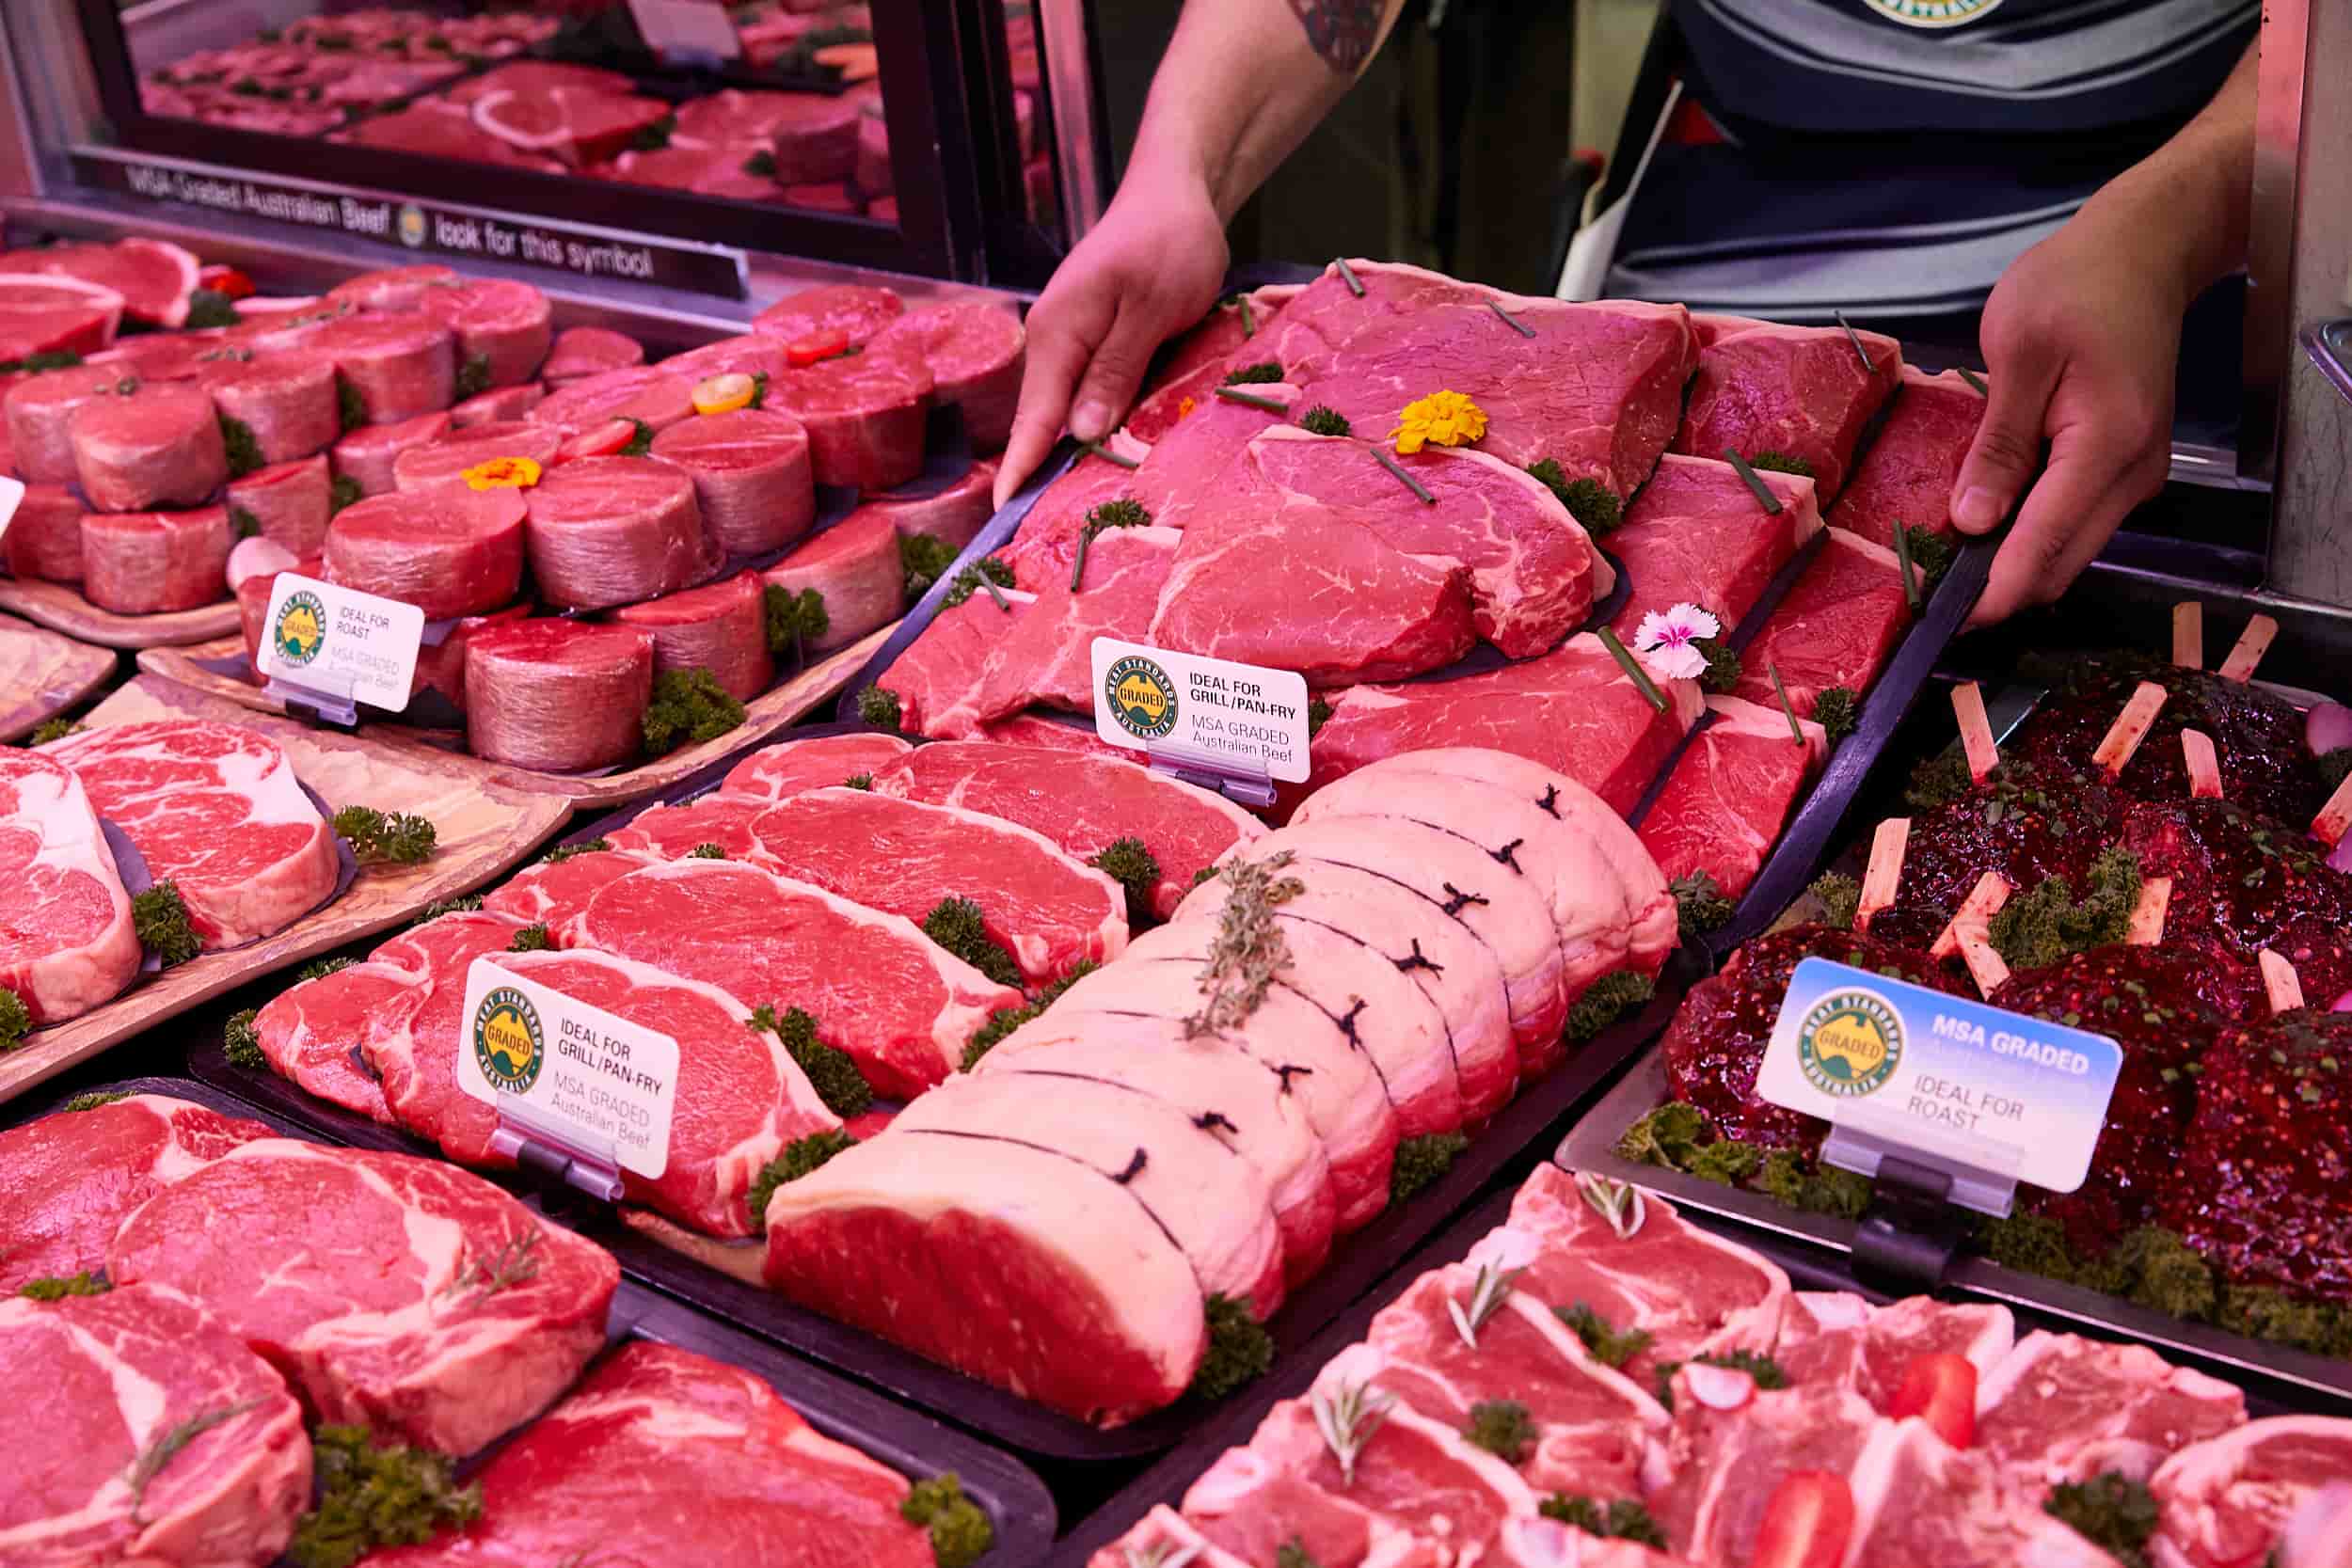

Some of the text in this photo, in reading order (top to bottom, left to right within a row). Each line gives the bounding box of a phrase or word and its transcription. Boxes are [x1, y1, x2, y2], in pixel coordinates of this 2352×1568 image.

[244, 182, 339, 225] Australian
[341, 196, 390, 233] Beef
[435, 213, 483, 250] look
[485, 221, 516, 256] for
[519, 229, 564, 264] this
[566, 242, 655, 278] symbol
[337, 621, 370, 640] ROAST
[340, 607, 389, 629] IDEAL FOR
[1108, 664, 1122, 694] MEAT
[1125, 658, 1175, 706] STANDARDS
[1189, 672, 1261, 697] IDEAL FOR
[1120, 688, 1164, 707] GRADED
[1116, 712, 1170, 737] AUSTRALIA
[1192, 714, 1289, 745] MSA GRADED
[1193, 731, 1292, 763] Australian Beef
[477, 998, 495, 1032] MEAT
[500, 990, 542, 1056] STANDARDS
[1804, 1003, 1833, 1037] MEAT
[1842, 997, 1899, 1060] STANDARDS
[487, 1025, 531, 1057] GRADED
[561, 1017, 630, 1061] IDEAL FOR
[1820, 1030, 1880, 1059] GRADED
[1932, 1014, 2089, 1075] MSA GRADED
[480, 1054, 532, 1091] AUSTRALIA
[1804, 1057, 1879, 1095] AUSTRALIA
[554, 1070, 649, 1128] MSA GRADED
[1908, 1096, 1979, 1129] ROAST
[1914, 1075, 2024, 1121] IDEAL FOR
[551, 1092, 650, 1149] Australian Beef
